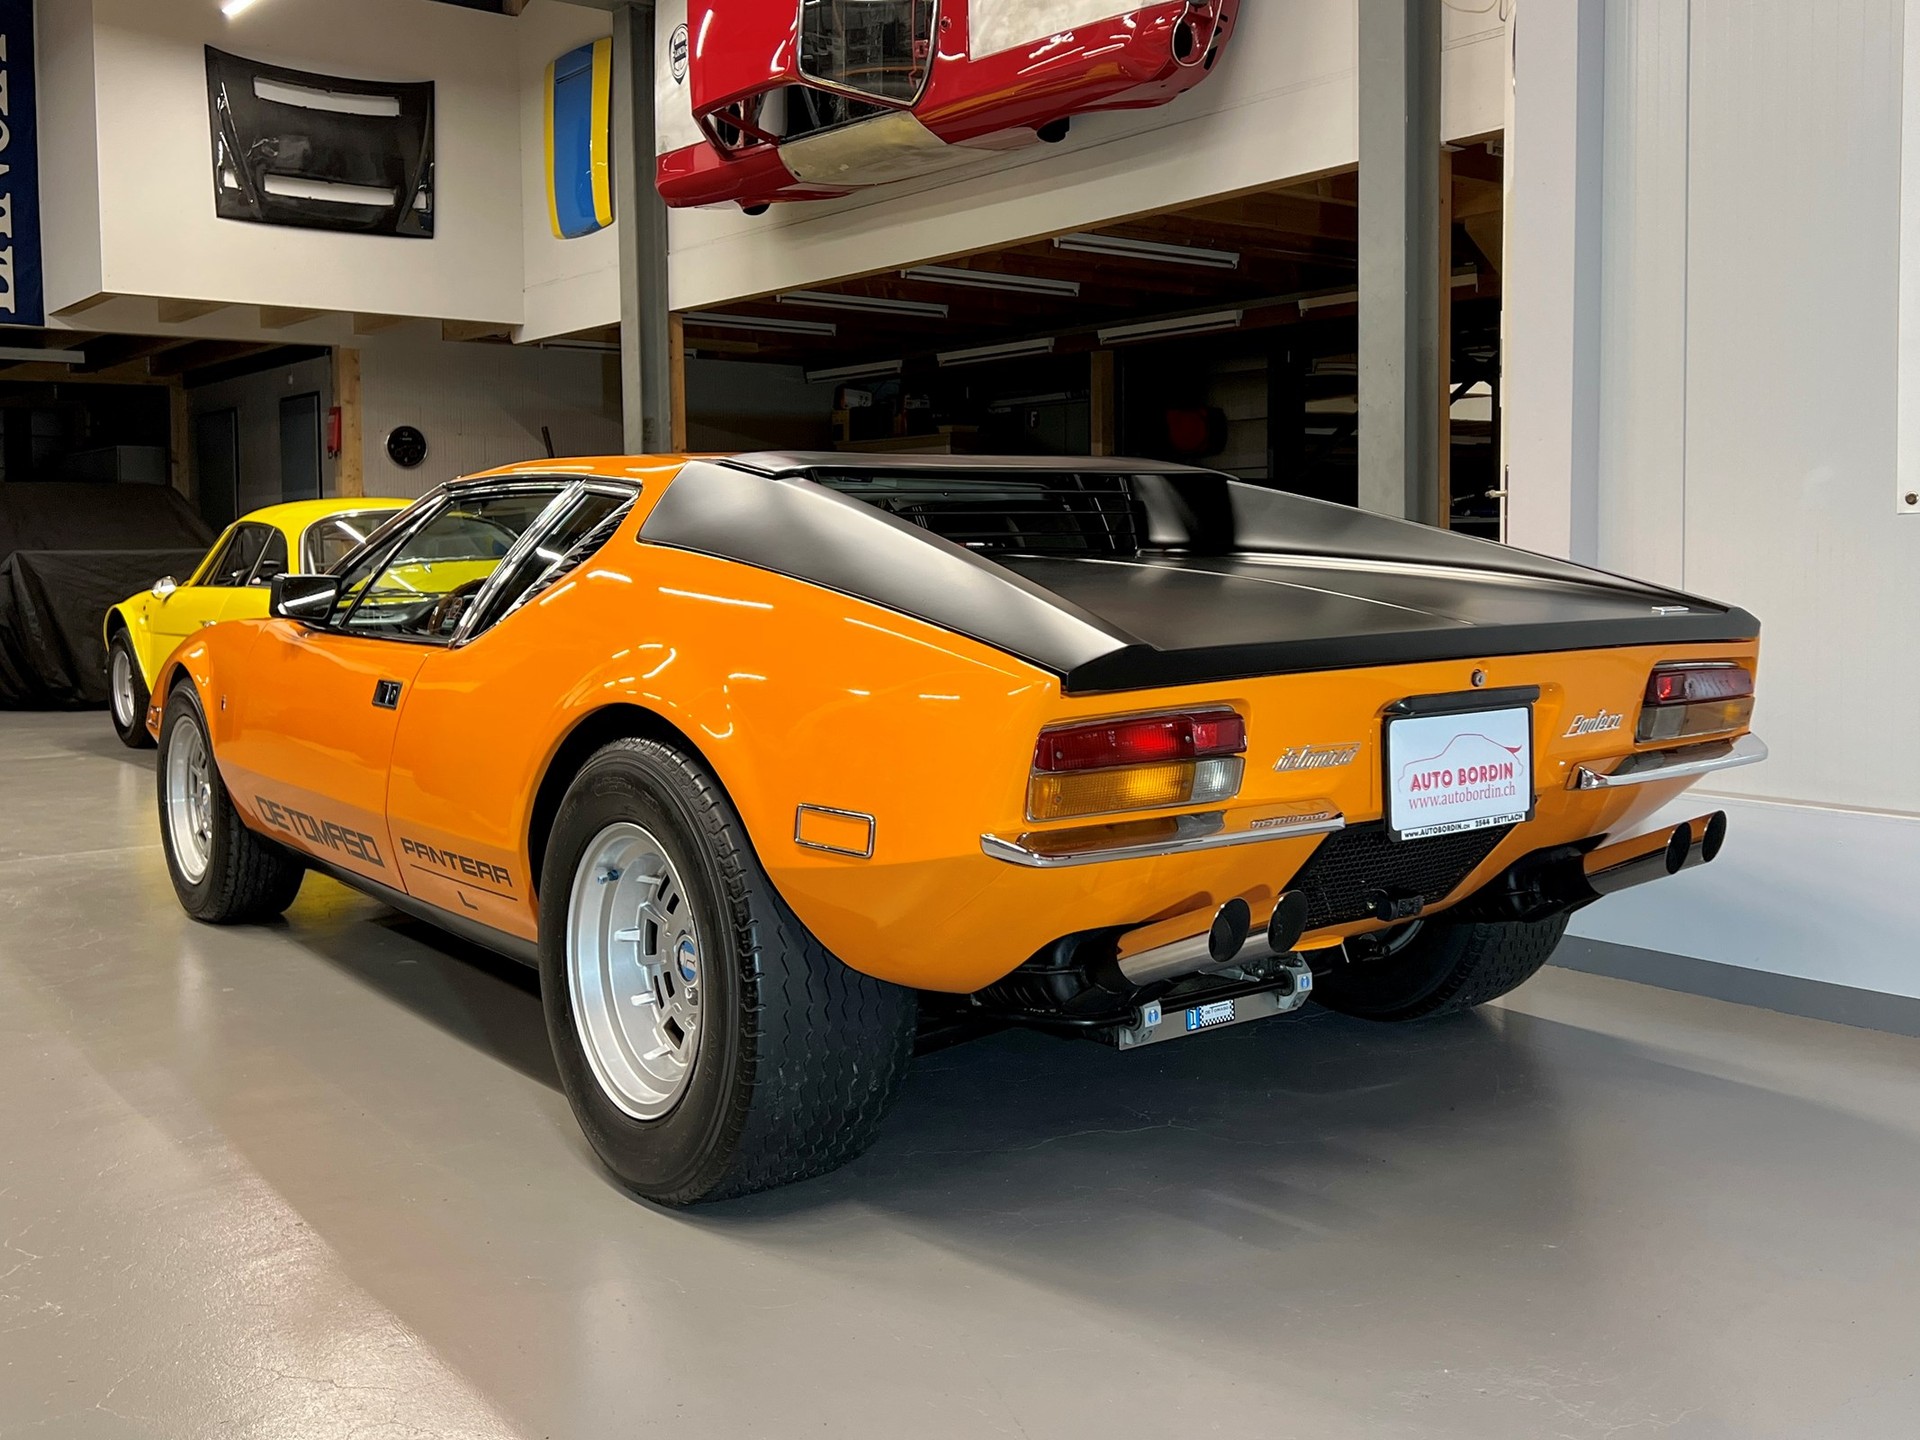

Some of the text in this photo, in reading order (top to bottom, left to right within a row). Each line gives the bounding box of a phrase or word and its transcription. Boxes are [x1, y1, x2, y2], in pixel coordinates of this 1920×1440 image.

[1410, 762, 1514, 793] AUTO BORDIN
[1408, 782, 1516, 810] www.autobordin.ch
[1493, 814, 1523, 825] BETTLACH
[400, 837, 514, 888] PANTERA
[457, 890, 479, 911] L
